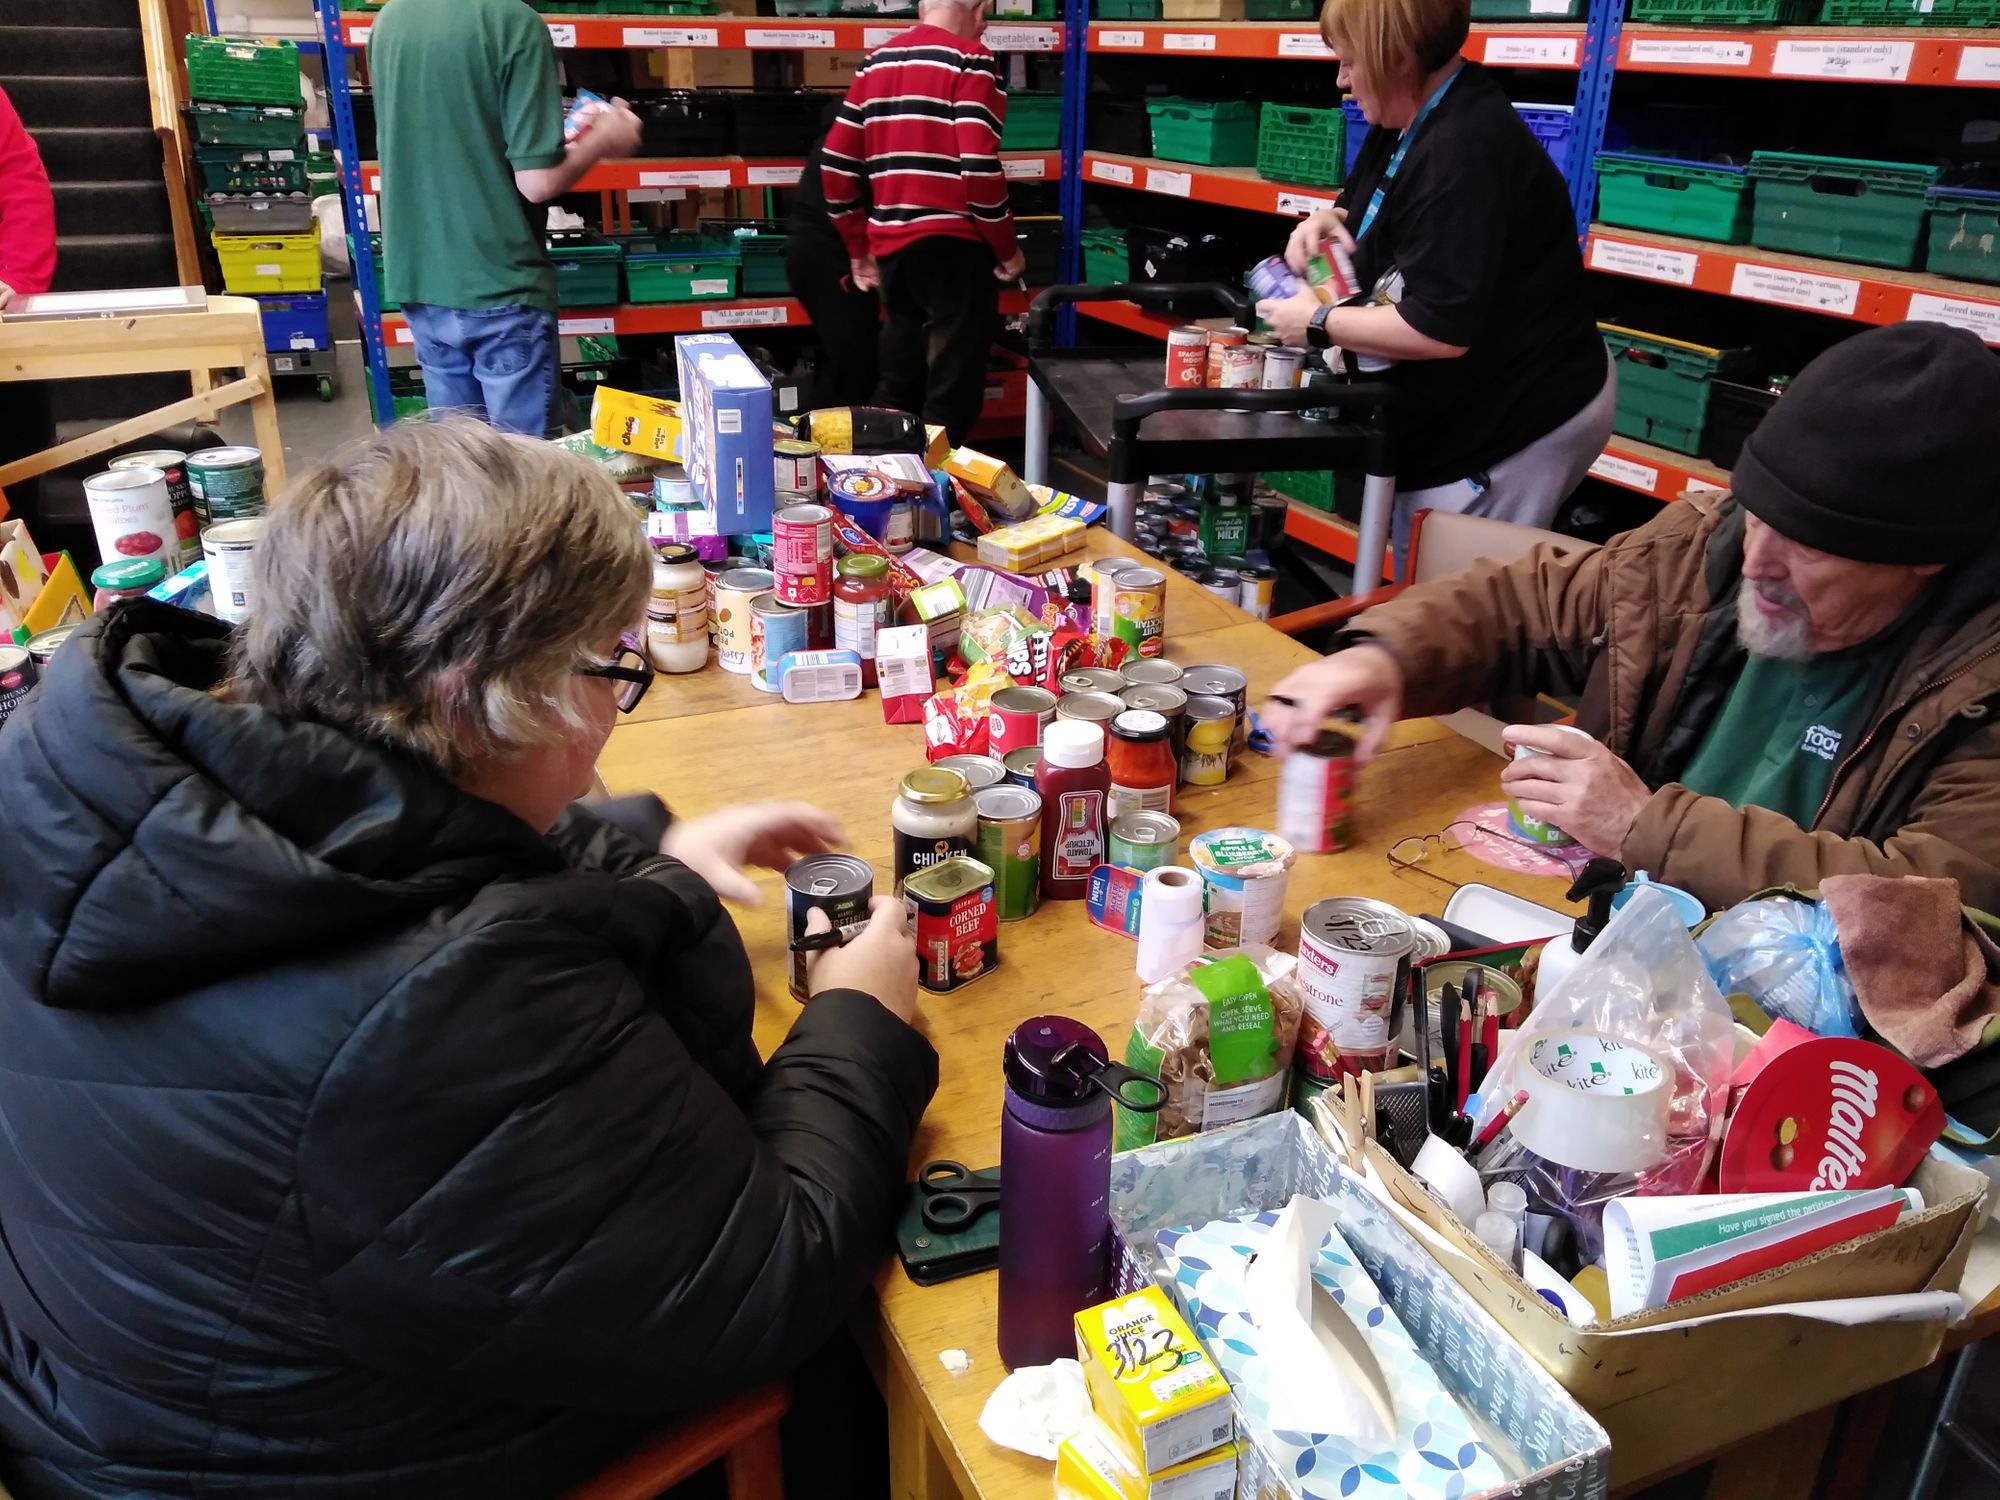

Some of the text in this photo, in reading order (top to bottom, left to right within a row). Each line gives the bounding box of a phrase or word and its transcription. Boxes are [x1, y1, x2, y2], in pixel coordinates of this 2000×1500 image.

[985, 33, 1035, 46] Vegetables
[1942, 303, 1996, 319] Jarred sauces
[1217, 530, 1240, 540] MILK
[1064, 839, 1095, 849] KETCHUP
[1066, 848, 1093, 857] TOMATO
[1214, 849, 1265, 857] BLUEBERRY
[949, 902, 987, 928] CORNED
[955, 917, 980, 938] BEEF
[1300, 945, 1335, 975] axters
[1222, 992, 1258, 1007] EASY OPEN
[1241, 1004, 1263, 1013] SERVE
[1213, 1011, 1270, 1027] WHAT YOU NEED
[1221, 1024, 1237, 1033] AND
[1718, 1222, 1741, 1235] Have
[1741, 1217, 1759, 1232] you
[1759, 1209, 1787, 1226] signed
[1786, 1207, 1801, 1218] the
[1801, 1199, 1835, 1215] petition
[1406, 1280, 1422, 1330] ENJOY
[1108, 1313, 1155, 1335] ORANGE
[1114, 1325, 1146, 1343] JUICE
[1443, 1324, 1463, 1373] ENJOY
